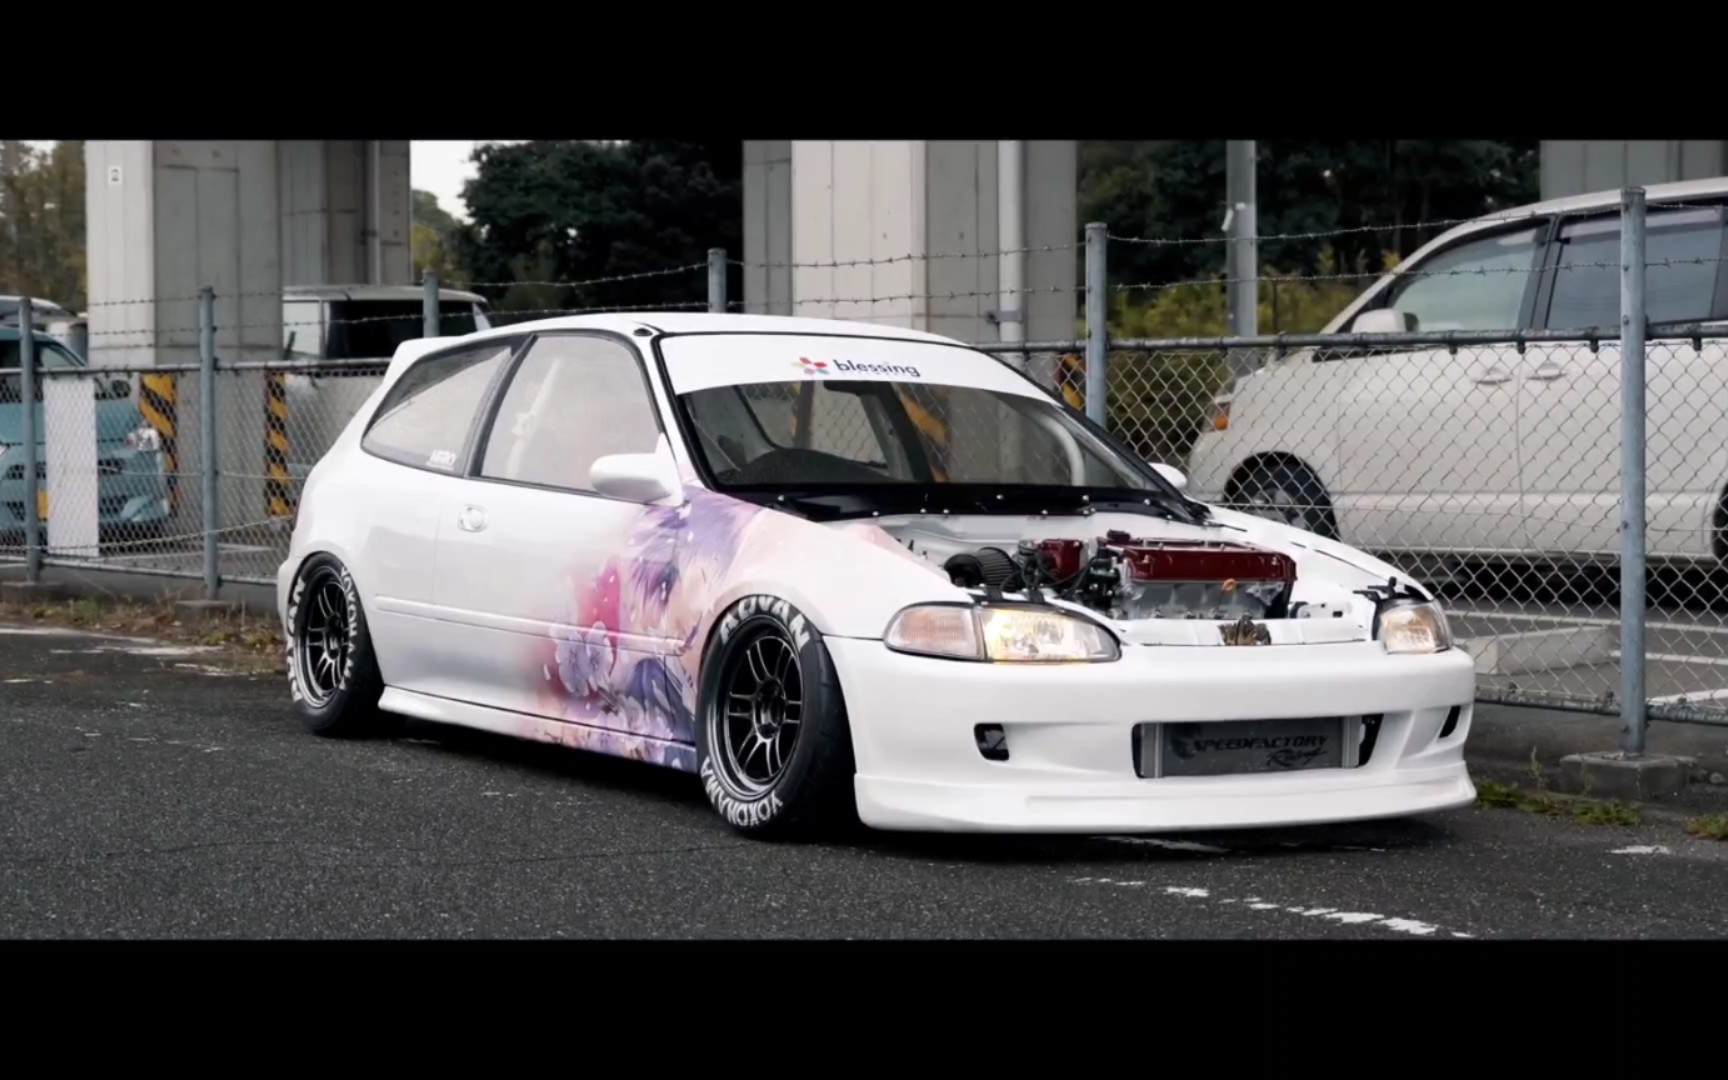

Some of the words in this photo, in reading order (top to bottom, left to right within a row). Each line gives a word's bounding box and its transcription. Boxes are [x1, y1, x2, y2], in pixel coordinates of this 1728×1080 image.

[833, 359, 921, 377] blessing
[720, 595, 810, 651] ADVAN
[1193, 735, 1328, 752] SPEEDFACTORY
[701, 755, 783, 827] YOKOHAMA
